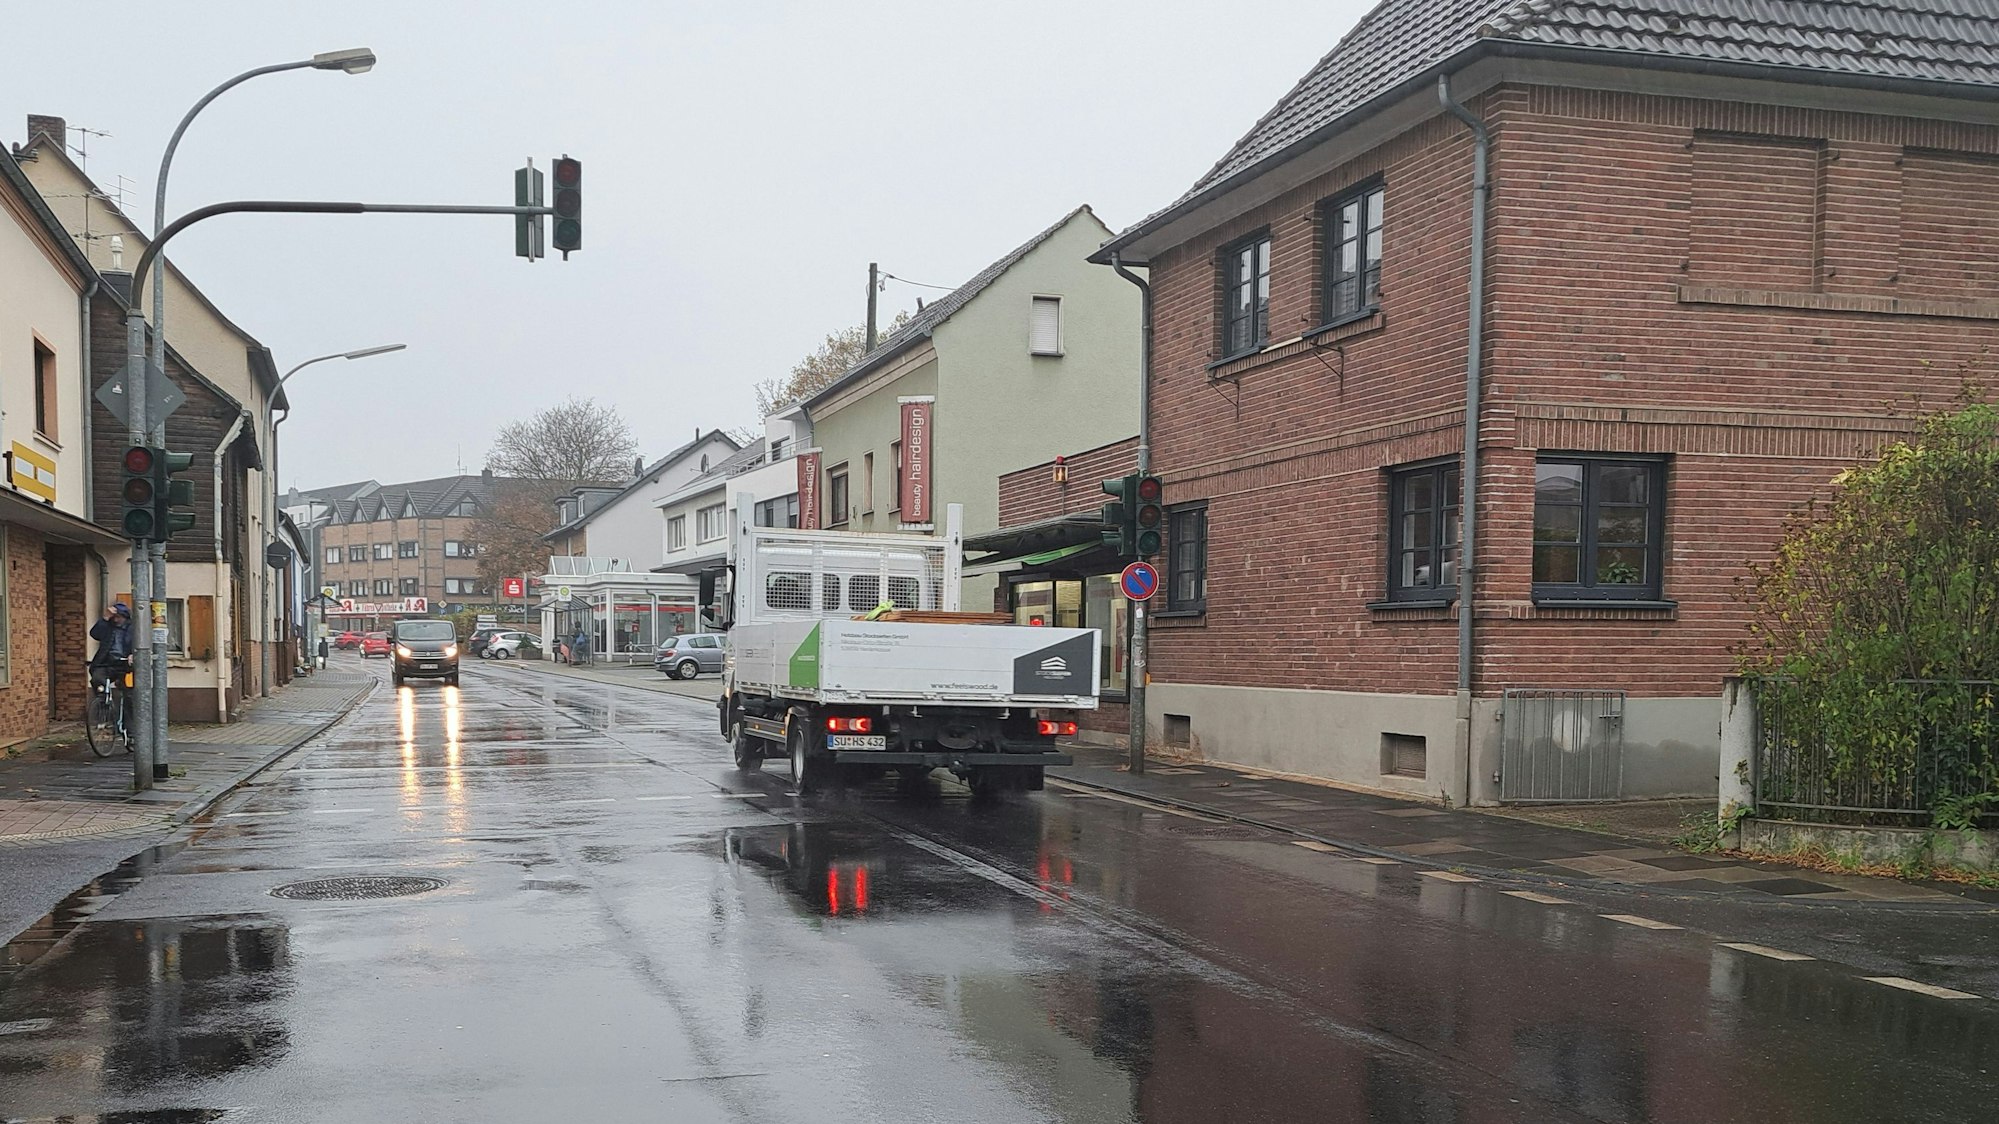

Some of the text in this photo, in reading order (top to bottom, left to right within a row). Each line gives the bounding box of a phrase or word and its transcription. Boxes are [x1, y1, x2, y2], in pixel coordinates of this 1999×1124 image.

[804, 458, 816, 515] hairdesign
[909, 408, 924, 517] beauty hairdesign
[834, 736, 884, 747] SU HS 432
